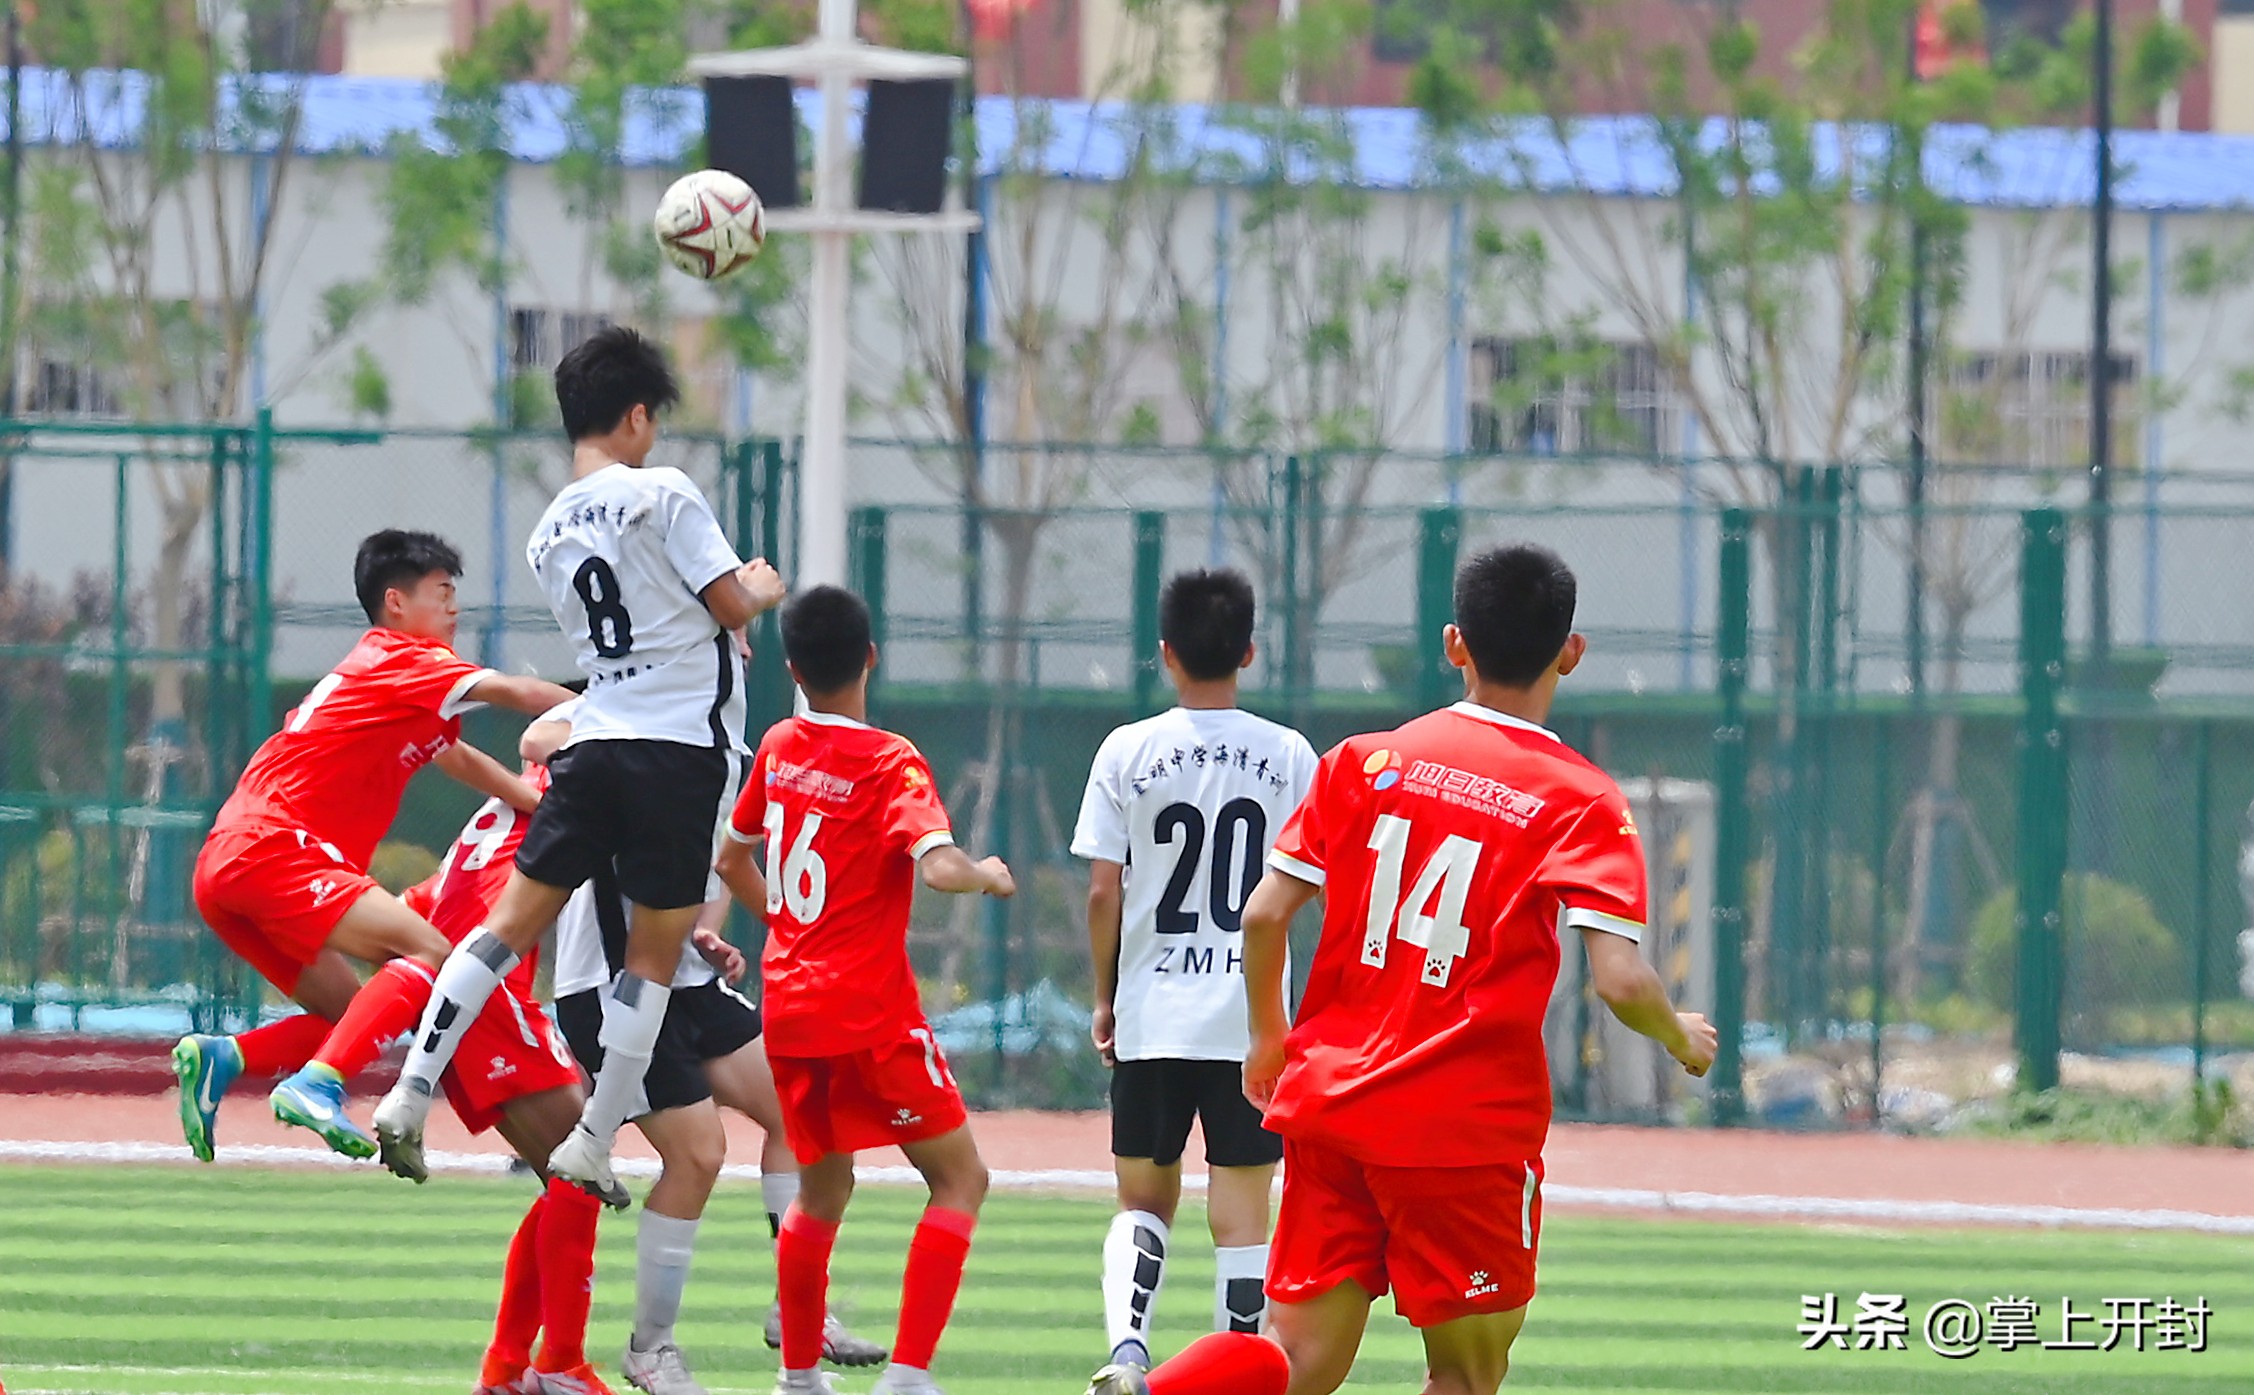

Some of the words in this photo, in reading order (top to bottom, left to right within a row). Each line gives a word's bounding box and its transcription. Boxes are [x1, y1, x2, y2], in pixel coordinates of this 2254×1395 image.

[573, 556, 633, 658] 8
[1404, 760, 1545, 818] 旭日教育
[1440, 789, 1529, 830] EDUCATION
[762, 800, 826, 925] 16
[1154, 796, 1267, 935] 20
[1360, 813, 1484, 989] 14
